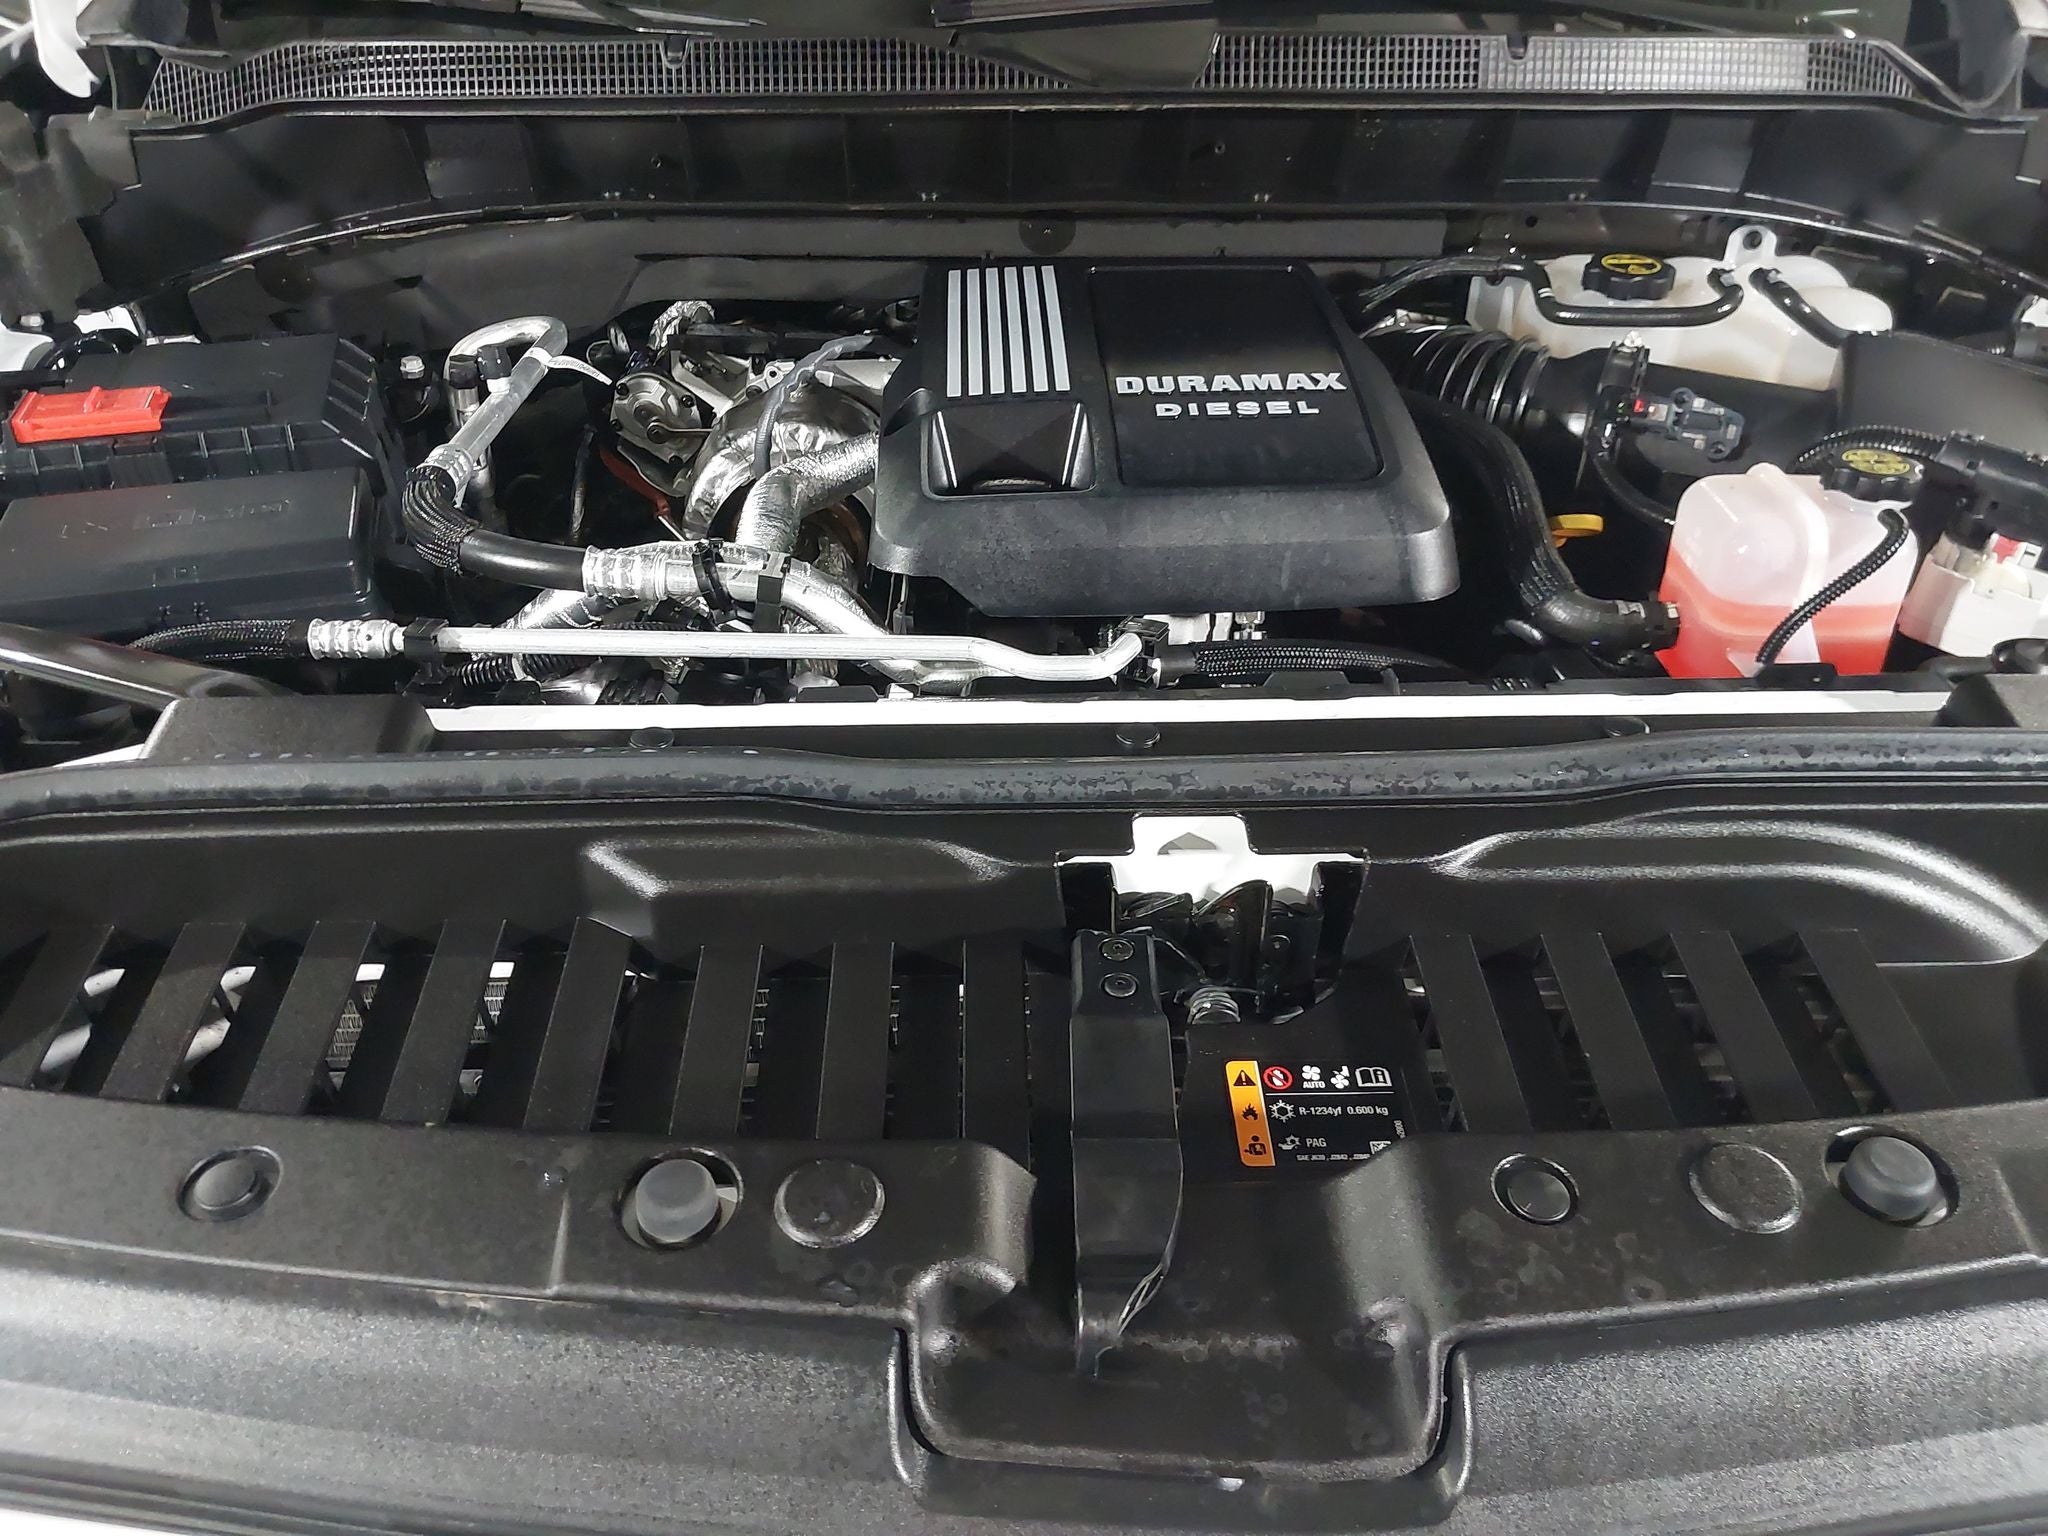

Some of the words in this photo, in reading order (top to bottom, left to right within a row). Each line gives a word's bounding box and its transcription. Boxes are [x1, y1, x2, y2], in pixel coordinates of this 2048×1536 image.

[1115, 371, 1348, 394] DURAMAX
[1155, 400, 1320, 417] DIESEL
[1302, 1081, 1326, 1089] AUTO
[1298, 1106, 1342, 1117] R-1234yf
[1346, 1106, 1374, 1115] 0.600
[1375, 1105, 1389, 1116] kg
[1306, 1138, 1327, 1148] PAG
